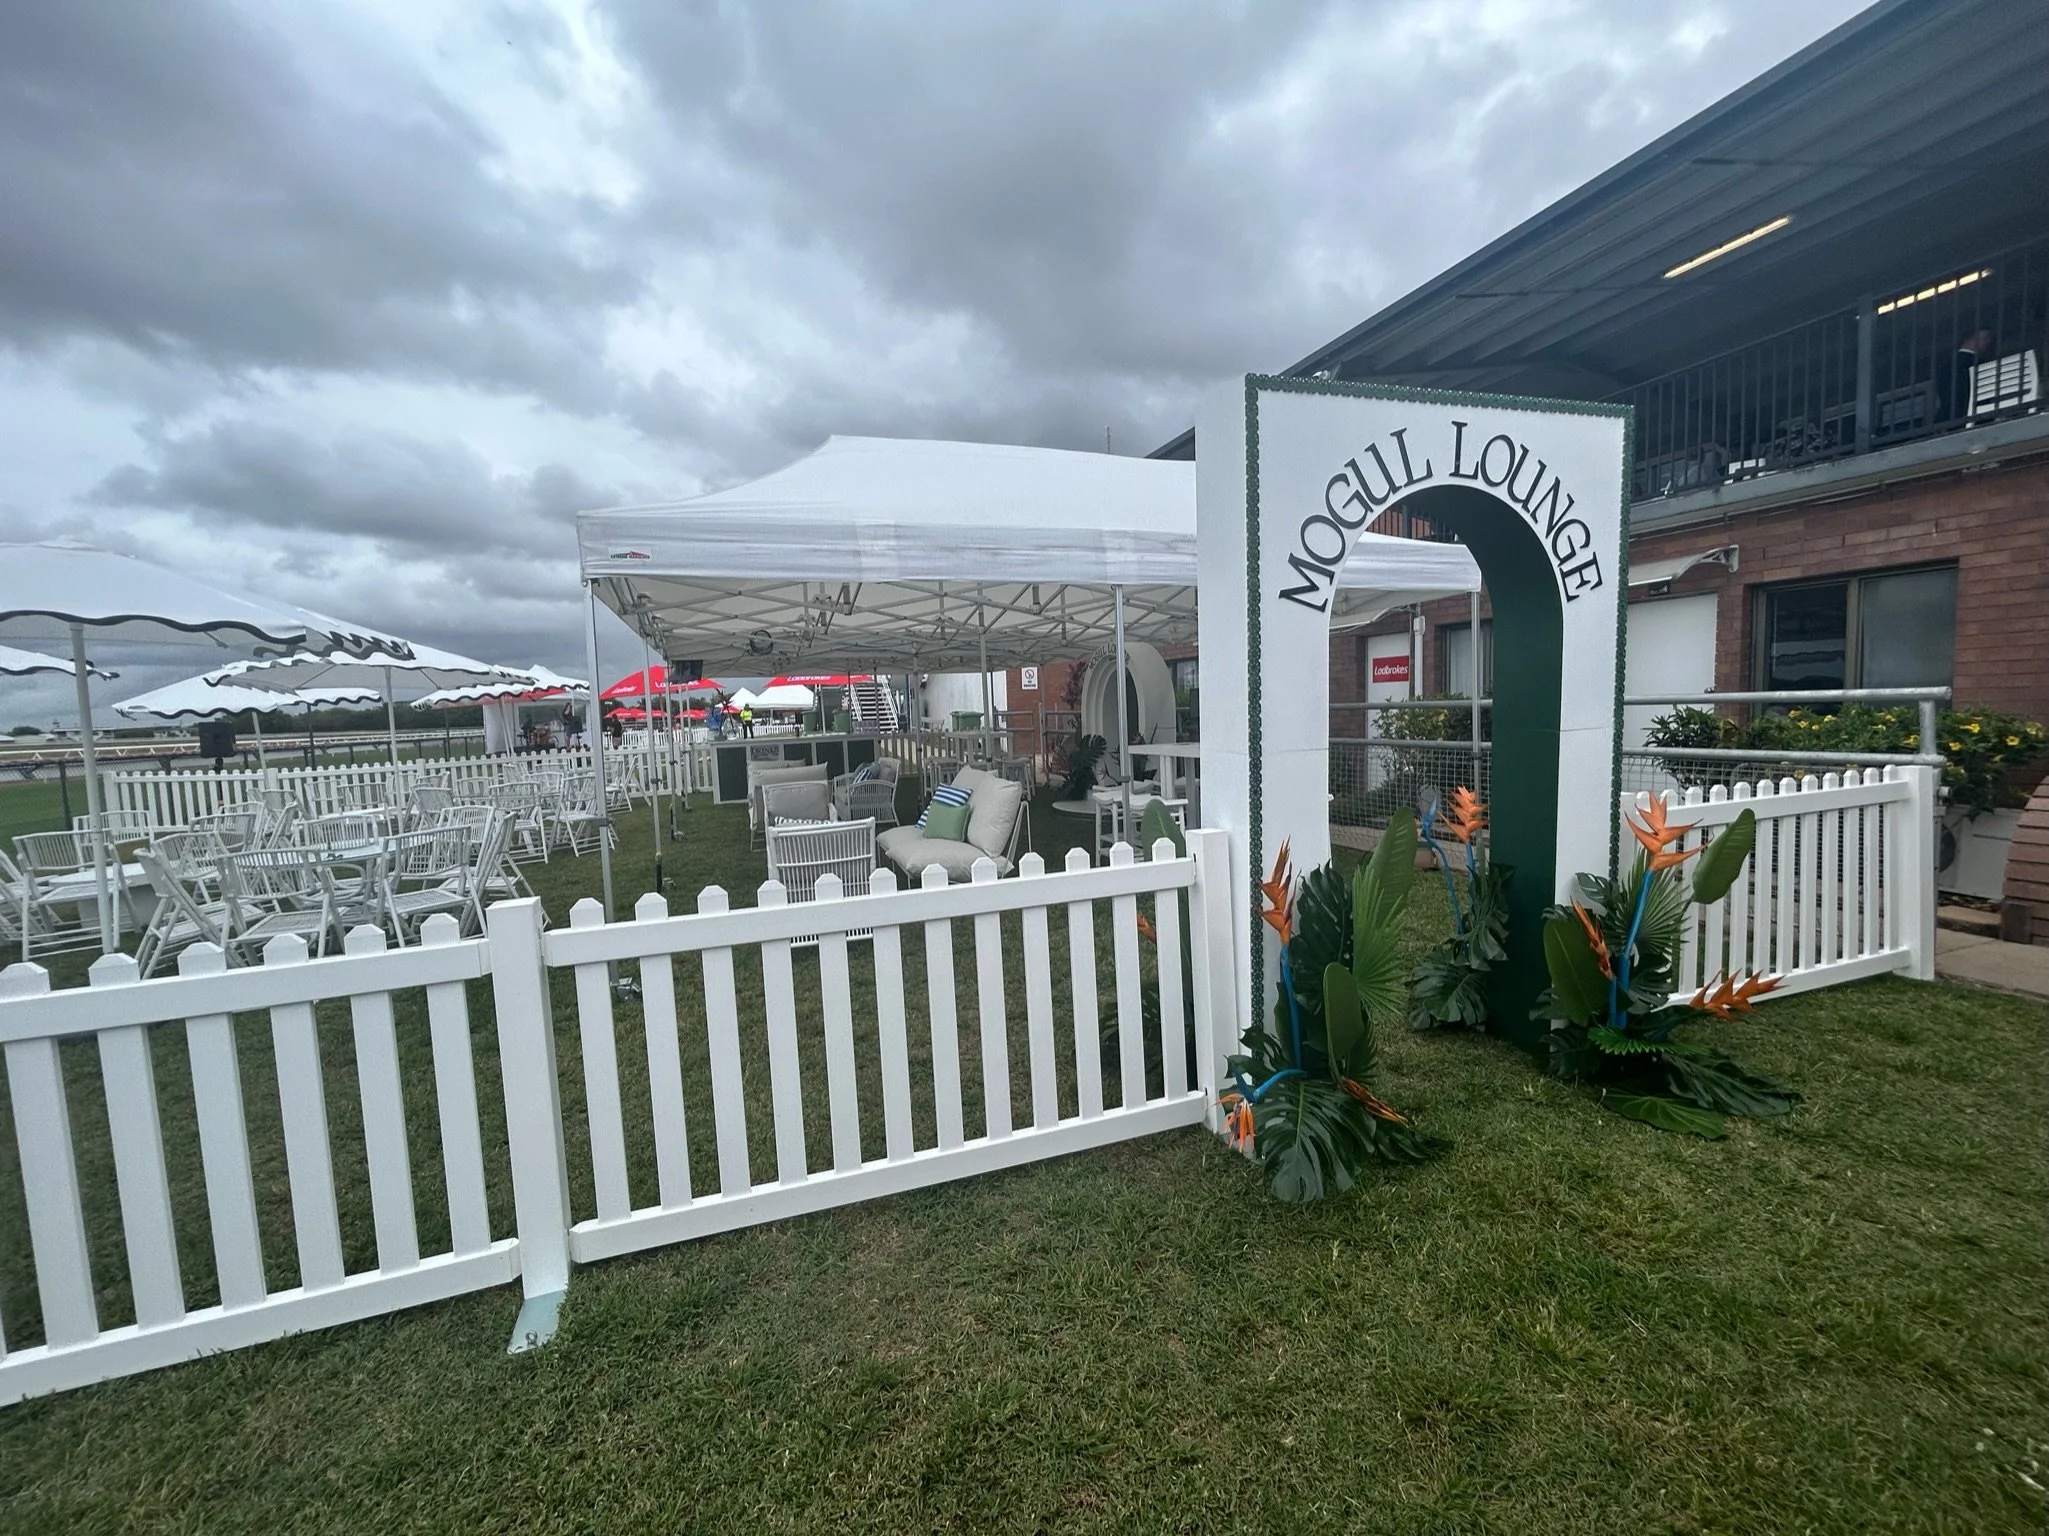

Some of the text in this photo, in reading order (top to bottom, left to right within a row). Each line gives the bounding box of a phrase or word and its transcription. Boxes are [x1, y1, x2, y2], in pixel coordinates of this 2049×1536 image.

[1278, 420, 1603, 612] MOGUL LOUNGE
[1375, 665, 1408, 676] Ladbrokes
